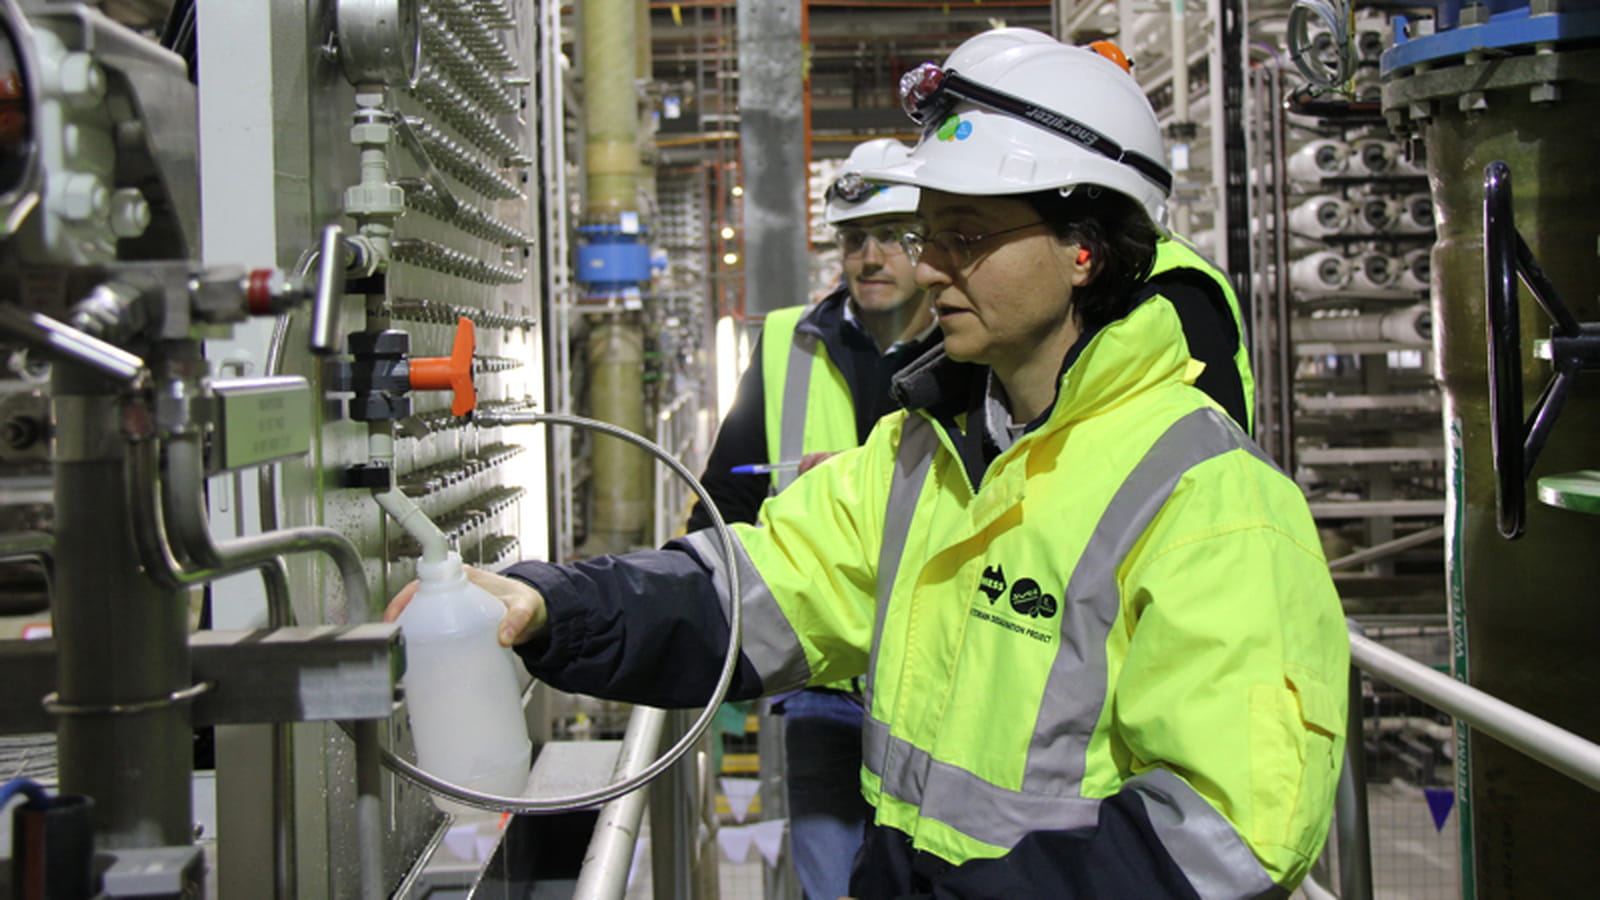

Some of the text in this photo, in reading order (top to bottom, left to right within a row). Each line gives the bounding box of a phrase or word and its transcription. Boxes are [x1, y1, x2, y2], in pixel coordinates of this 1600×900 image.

[1024, 106, 1099, 146] Energizer
[1026, 628, 1052, 643] PROJECT
[1452, 584, 1465, 659] WATER
